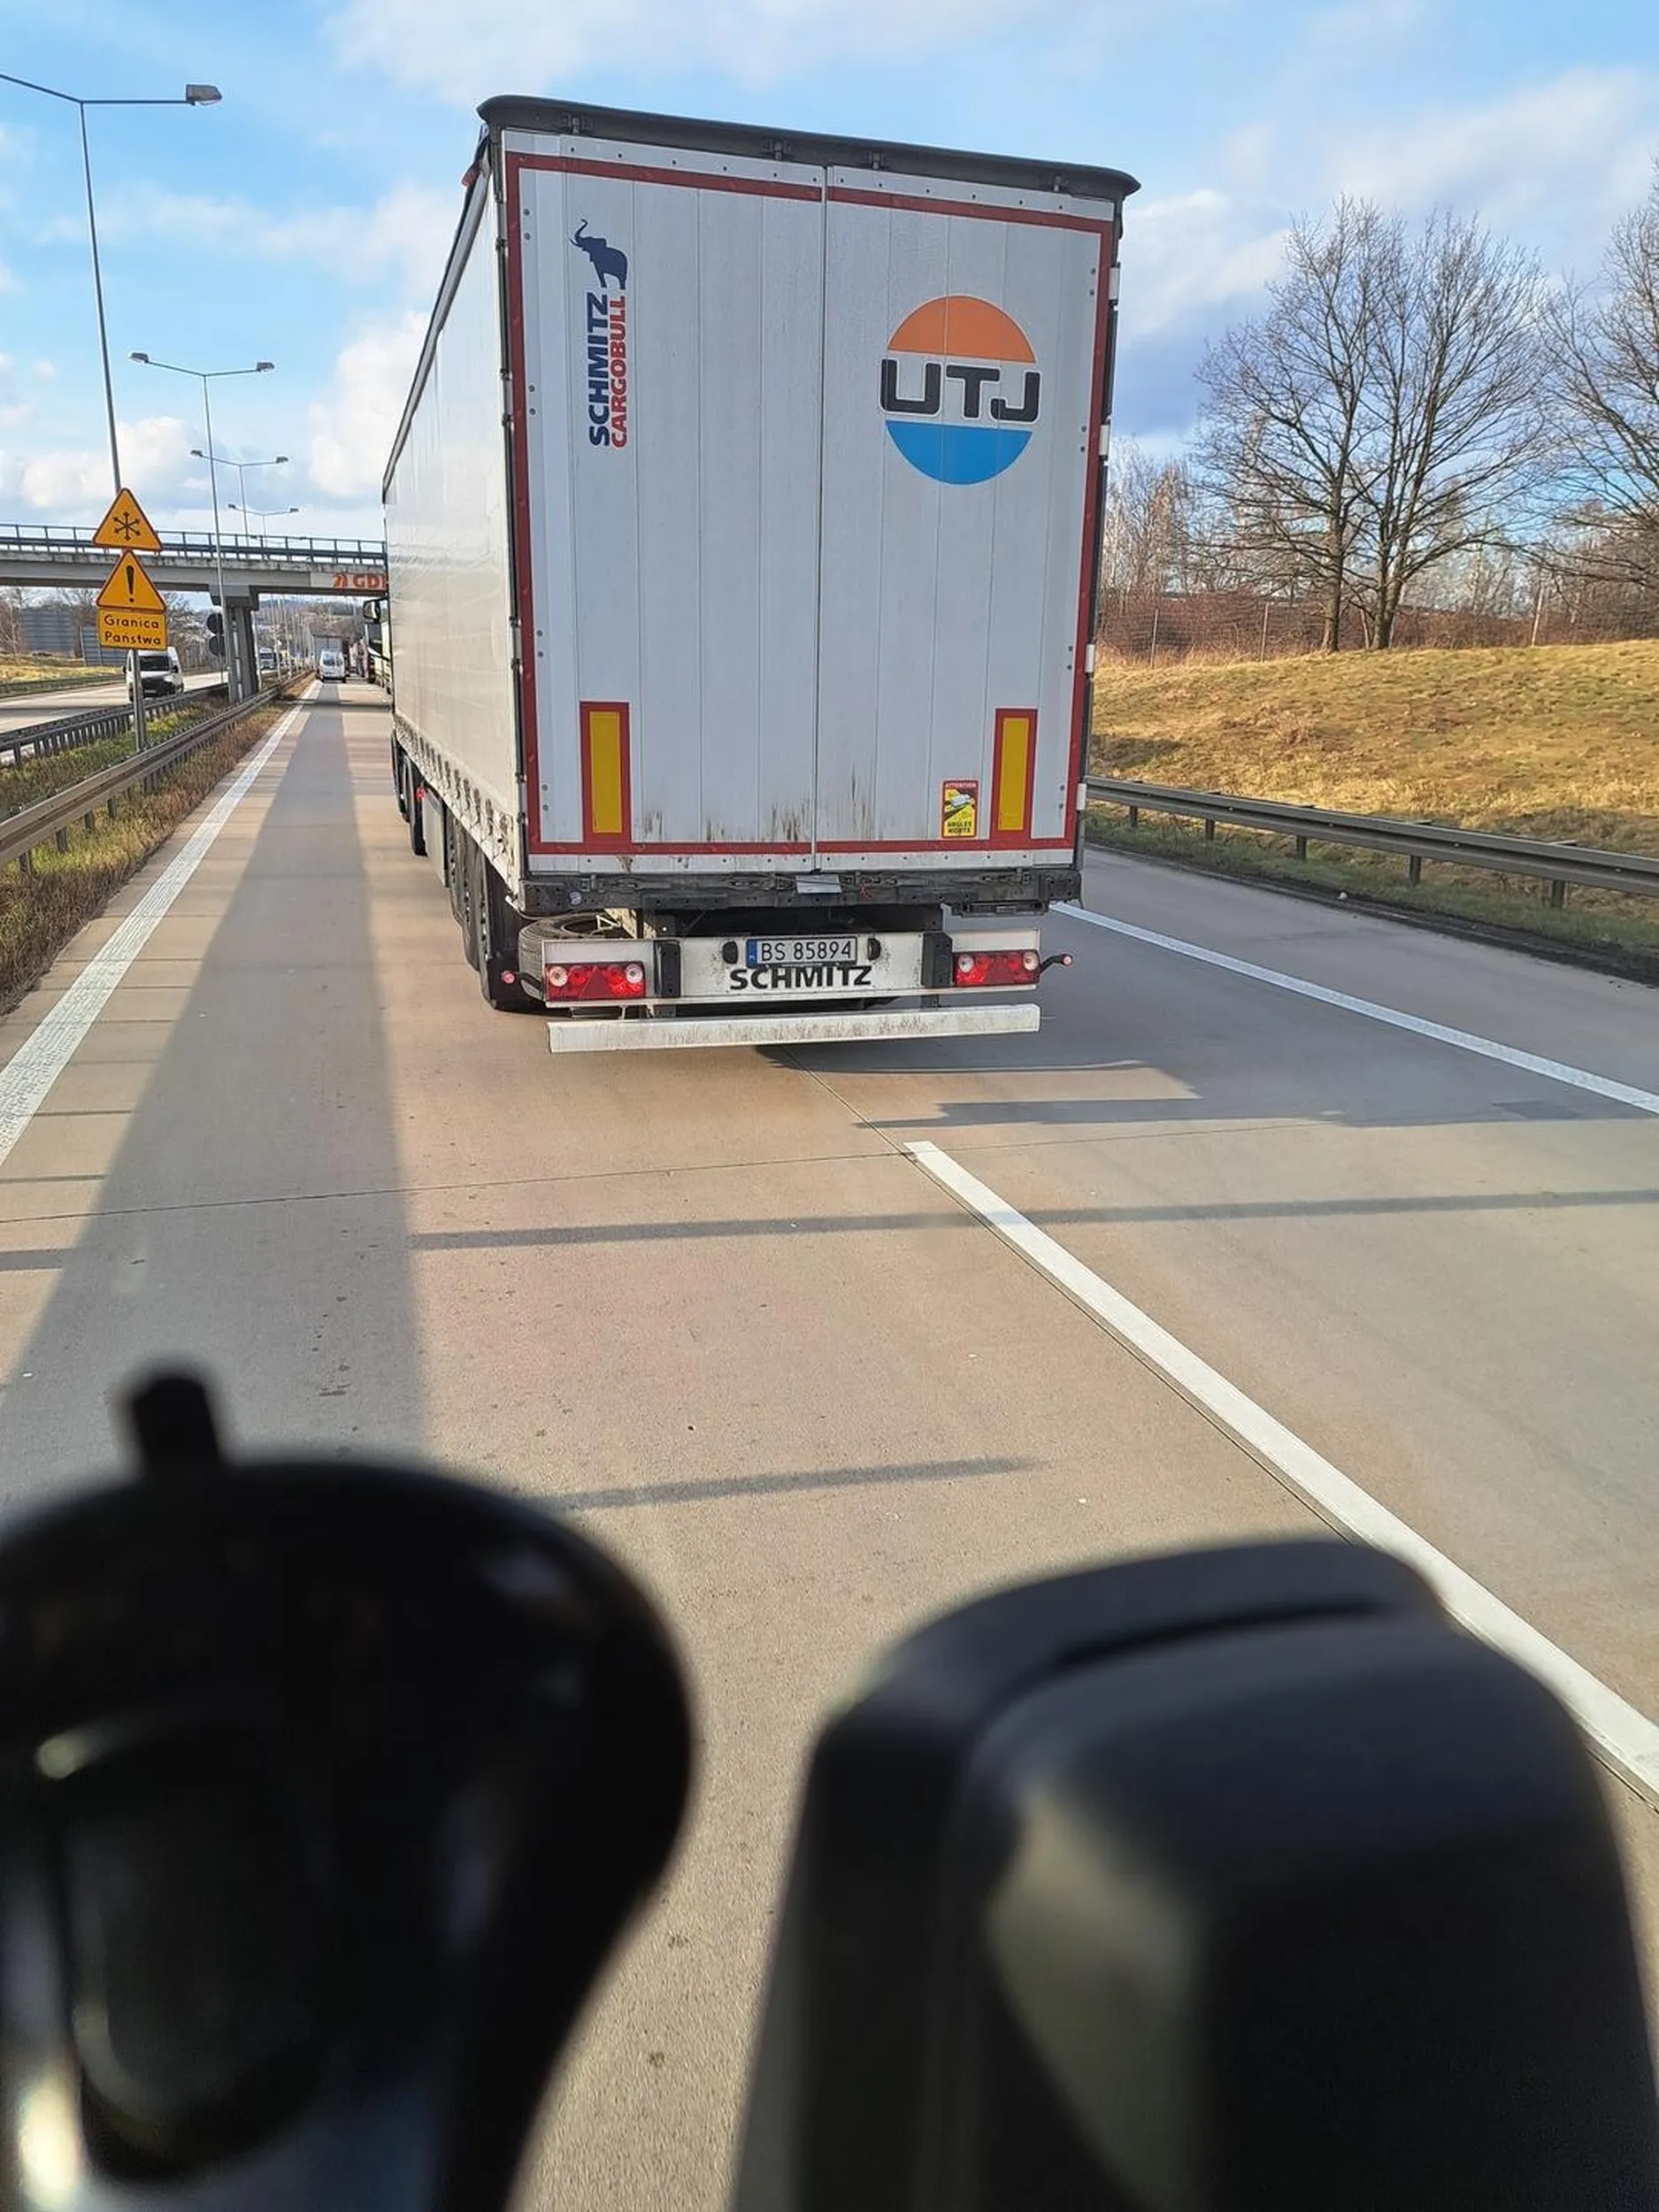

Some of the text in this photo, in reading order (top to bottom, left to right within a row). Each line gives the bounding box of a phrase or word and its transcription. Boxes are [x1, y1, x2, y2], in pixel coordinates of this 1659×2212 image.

[587, 292, 610, 446] SCHMITZ
[609, 295, 627, 448] CARGOBULL
[879, 358, 1041, 423] UTJ
[104, 614, 159, 629] Granica
[104, 631, 161, 645] Państwa
[761, 941, 851, 962] BS 85894
[729, 965, 872, 990] SCHMITZ
